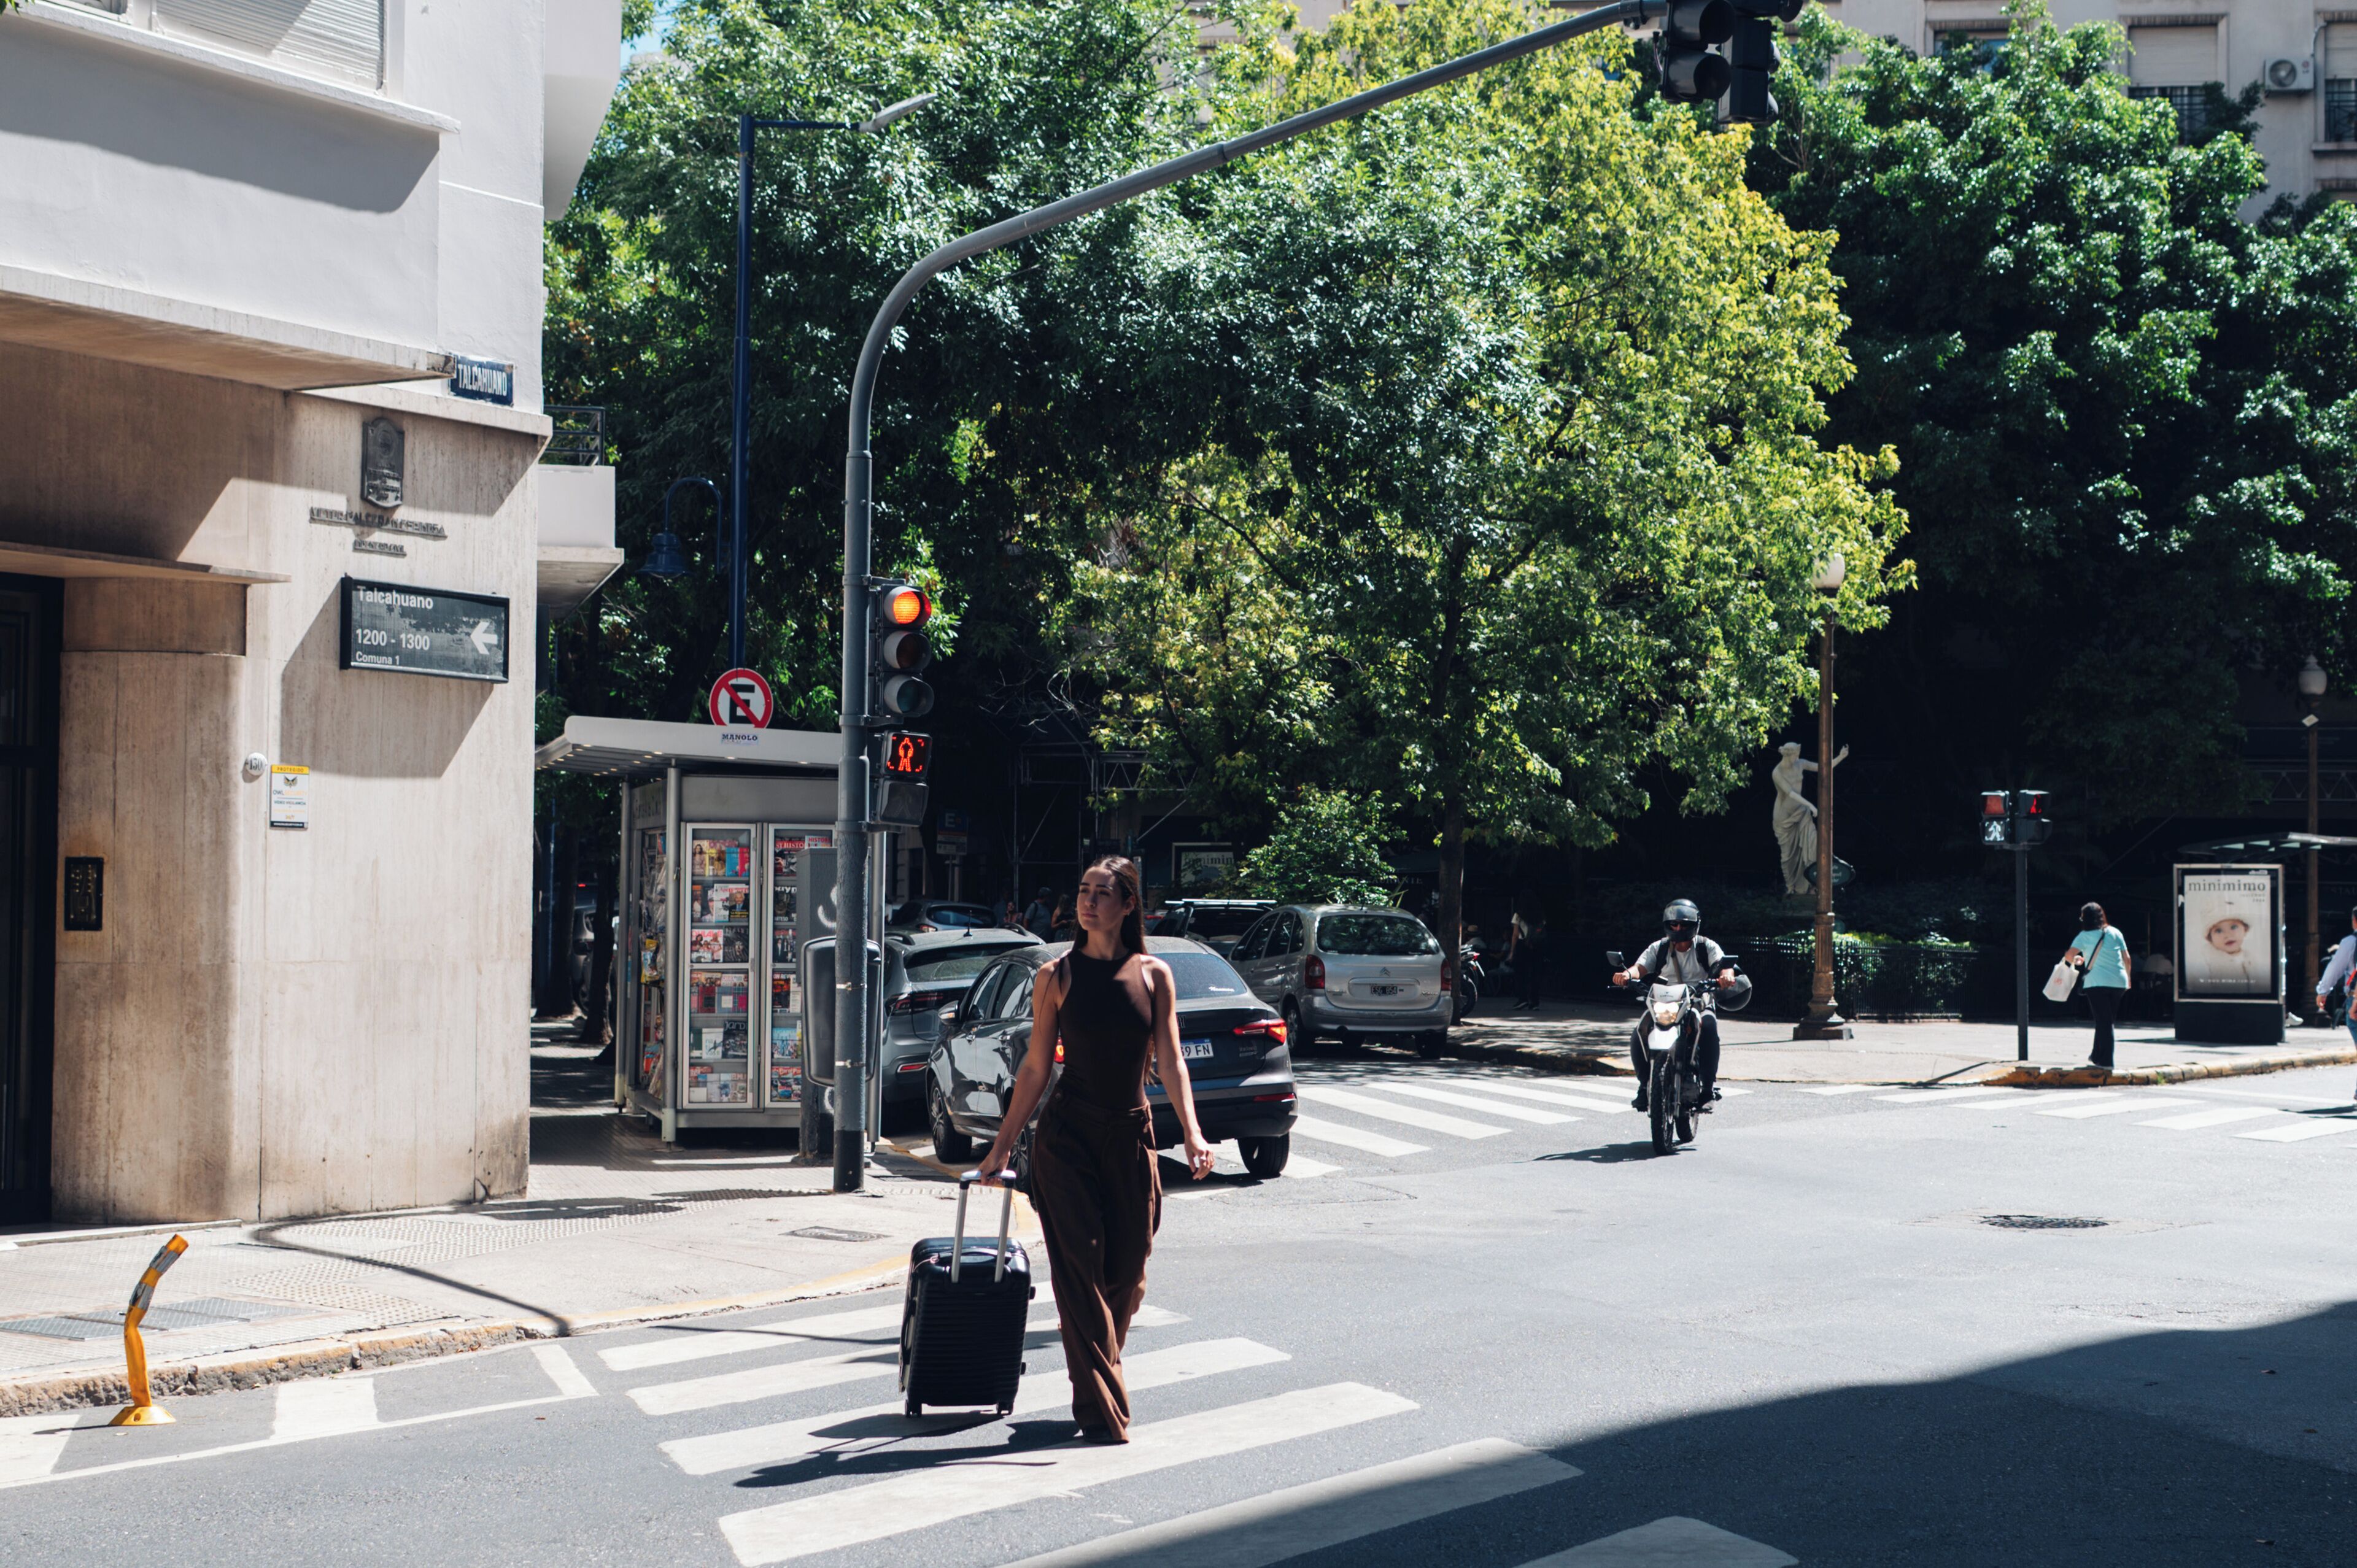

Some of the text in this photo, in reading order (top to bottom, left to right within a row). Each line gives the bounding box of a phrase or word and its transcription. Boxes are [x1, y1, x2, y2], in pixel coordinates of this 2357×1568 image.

[457, 363, 507, 396] TALCAHUANO
[357, 585, 433, 609] Talcahuano
[356, 628, 387, 646] 1200
[400, 633, 430, 651] 1300
[355, 651, 400, 665] Comuna 1
[945, 813, 956, 828] E
[2188, 879, 2266, 892] minimimo
[1194, 1043, 1210, 1056] FN
